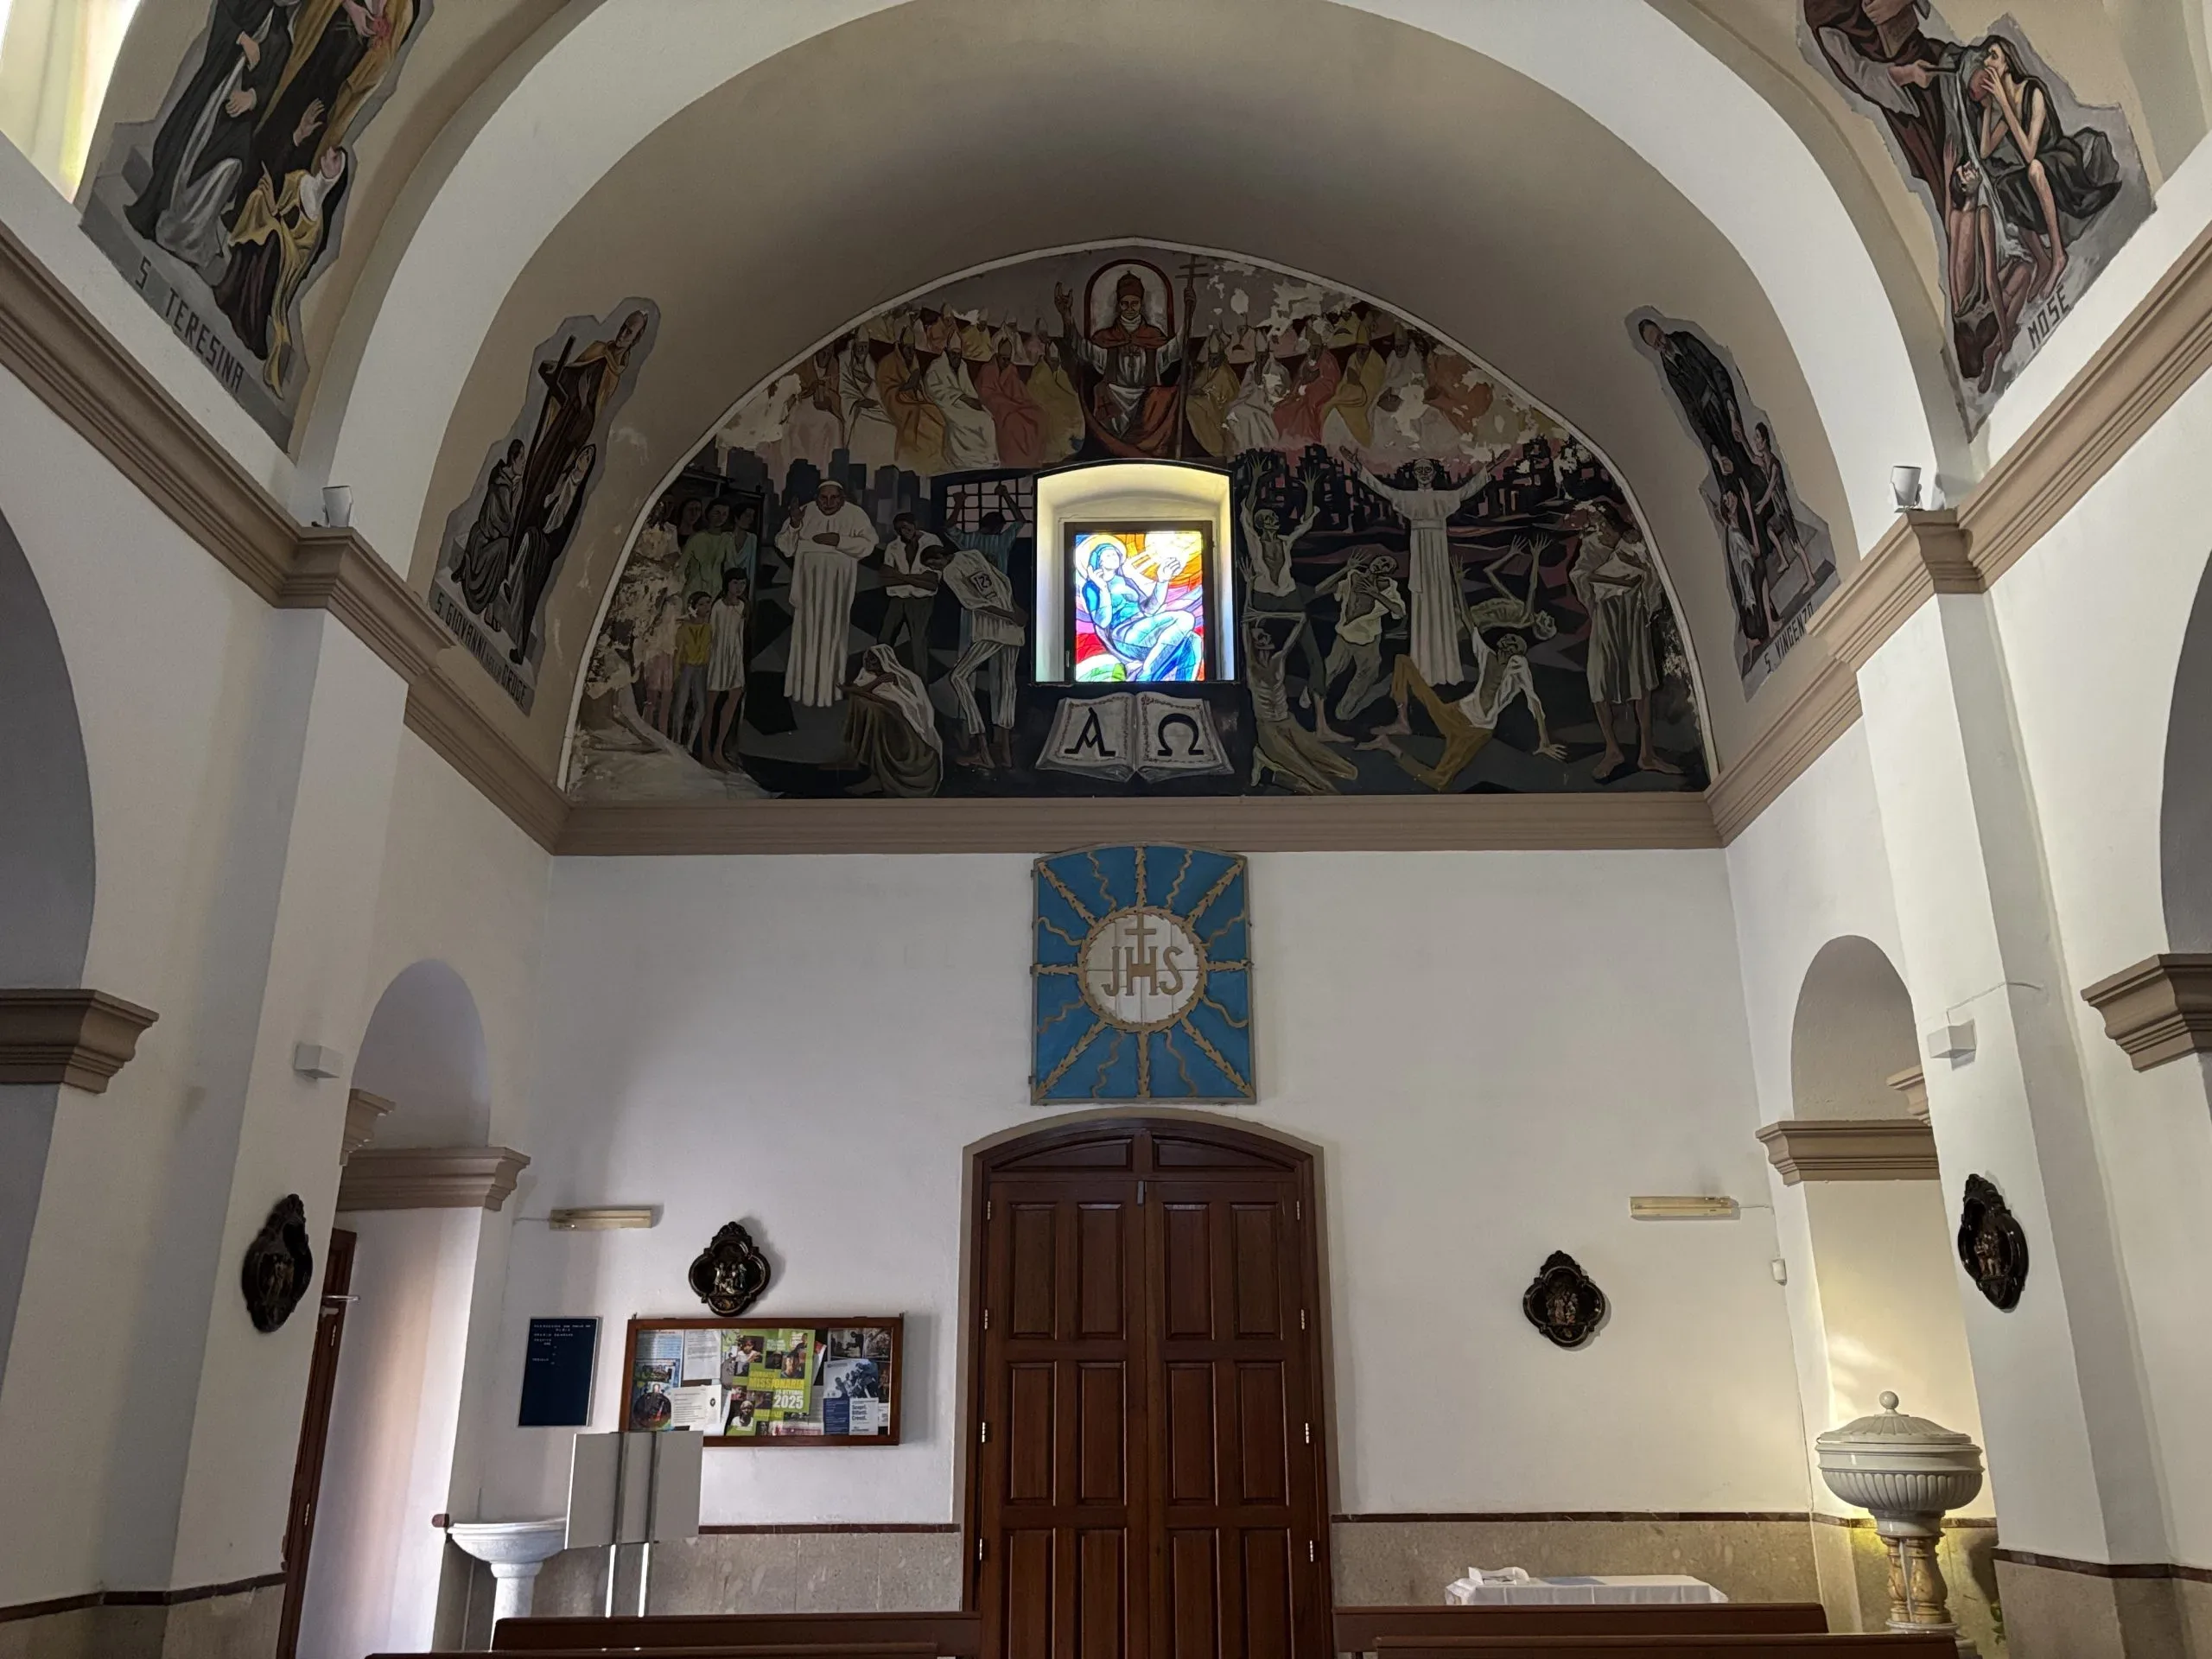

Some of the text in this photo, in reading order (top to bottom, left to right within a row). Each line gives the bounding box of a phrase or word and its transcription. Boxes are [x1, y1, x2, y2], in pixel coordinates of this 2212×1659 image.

[165, 287, 245, 393] TERESINA
[446, 604, 487, 661] GIOVANNI
[1775, 601, 1815, 660] VINCENZO
[1157, 713, 1205, 757] Ω
[772, 1395, 804, 1409] 2025
